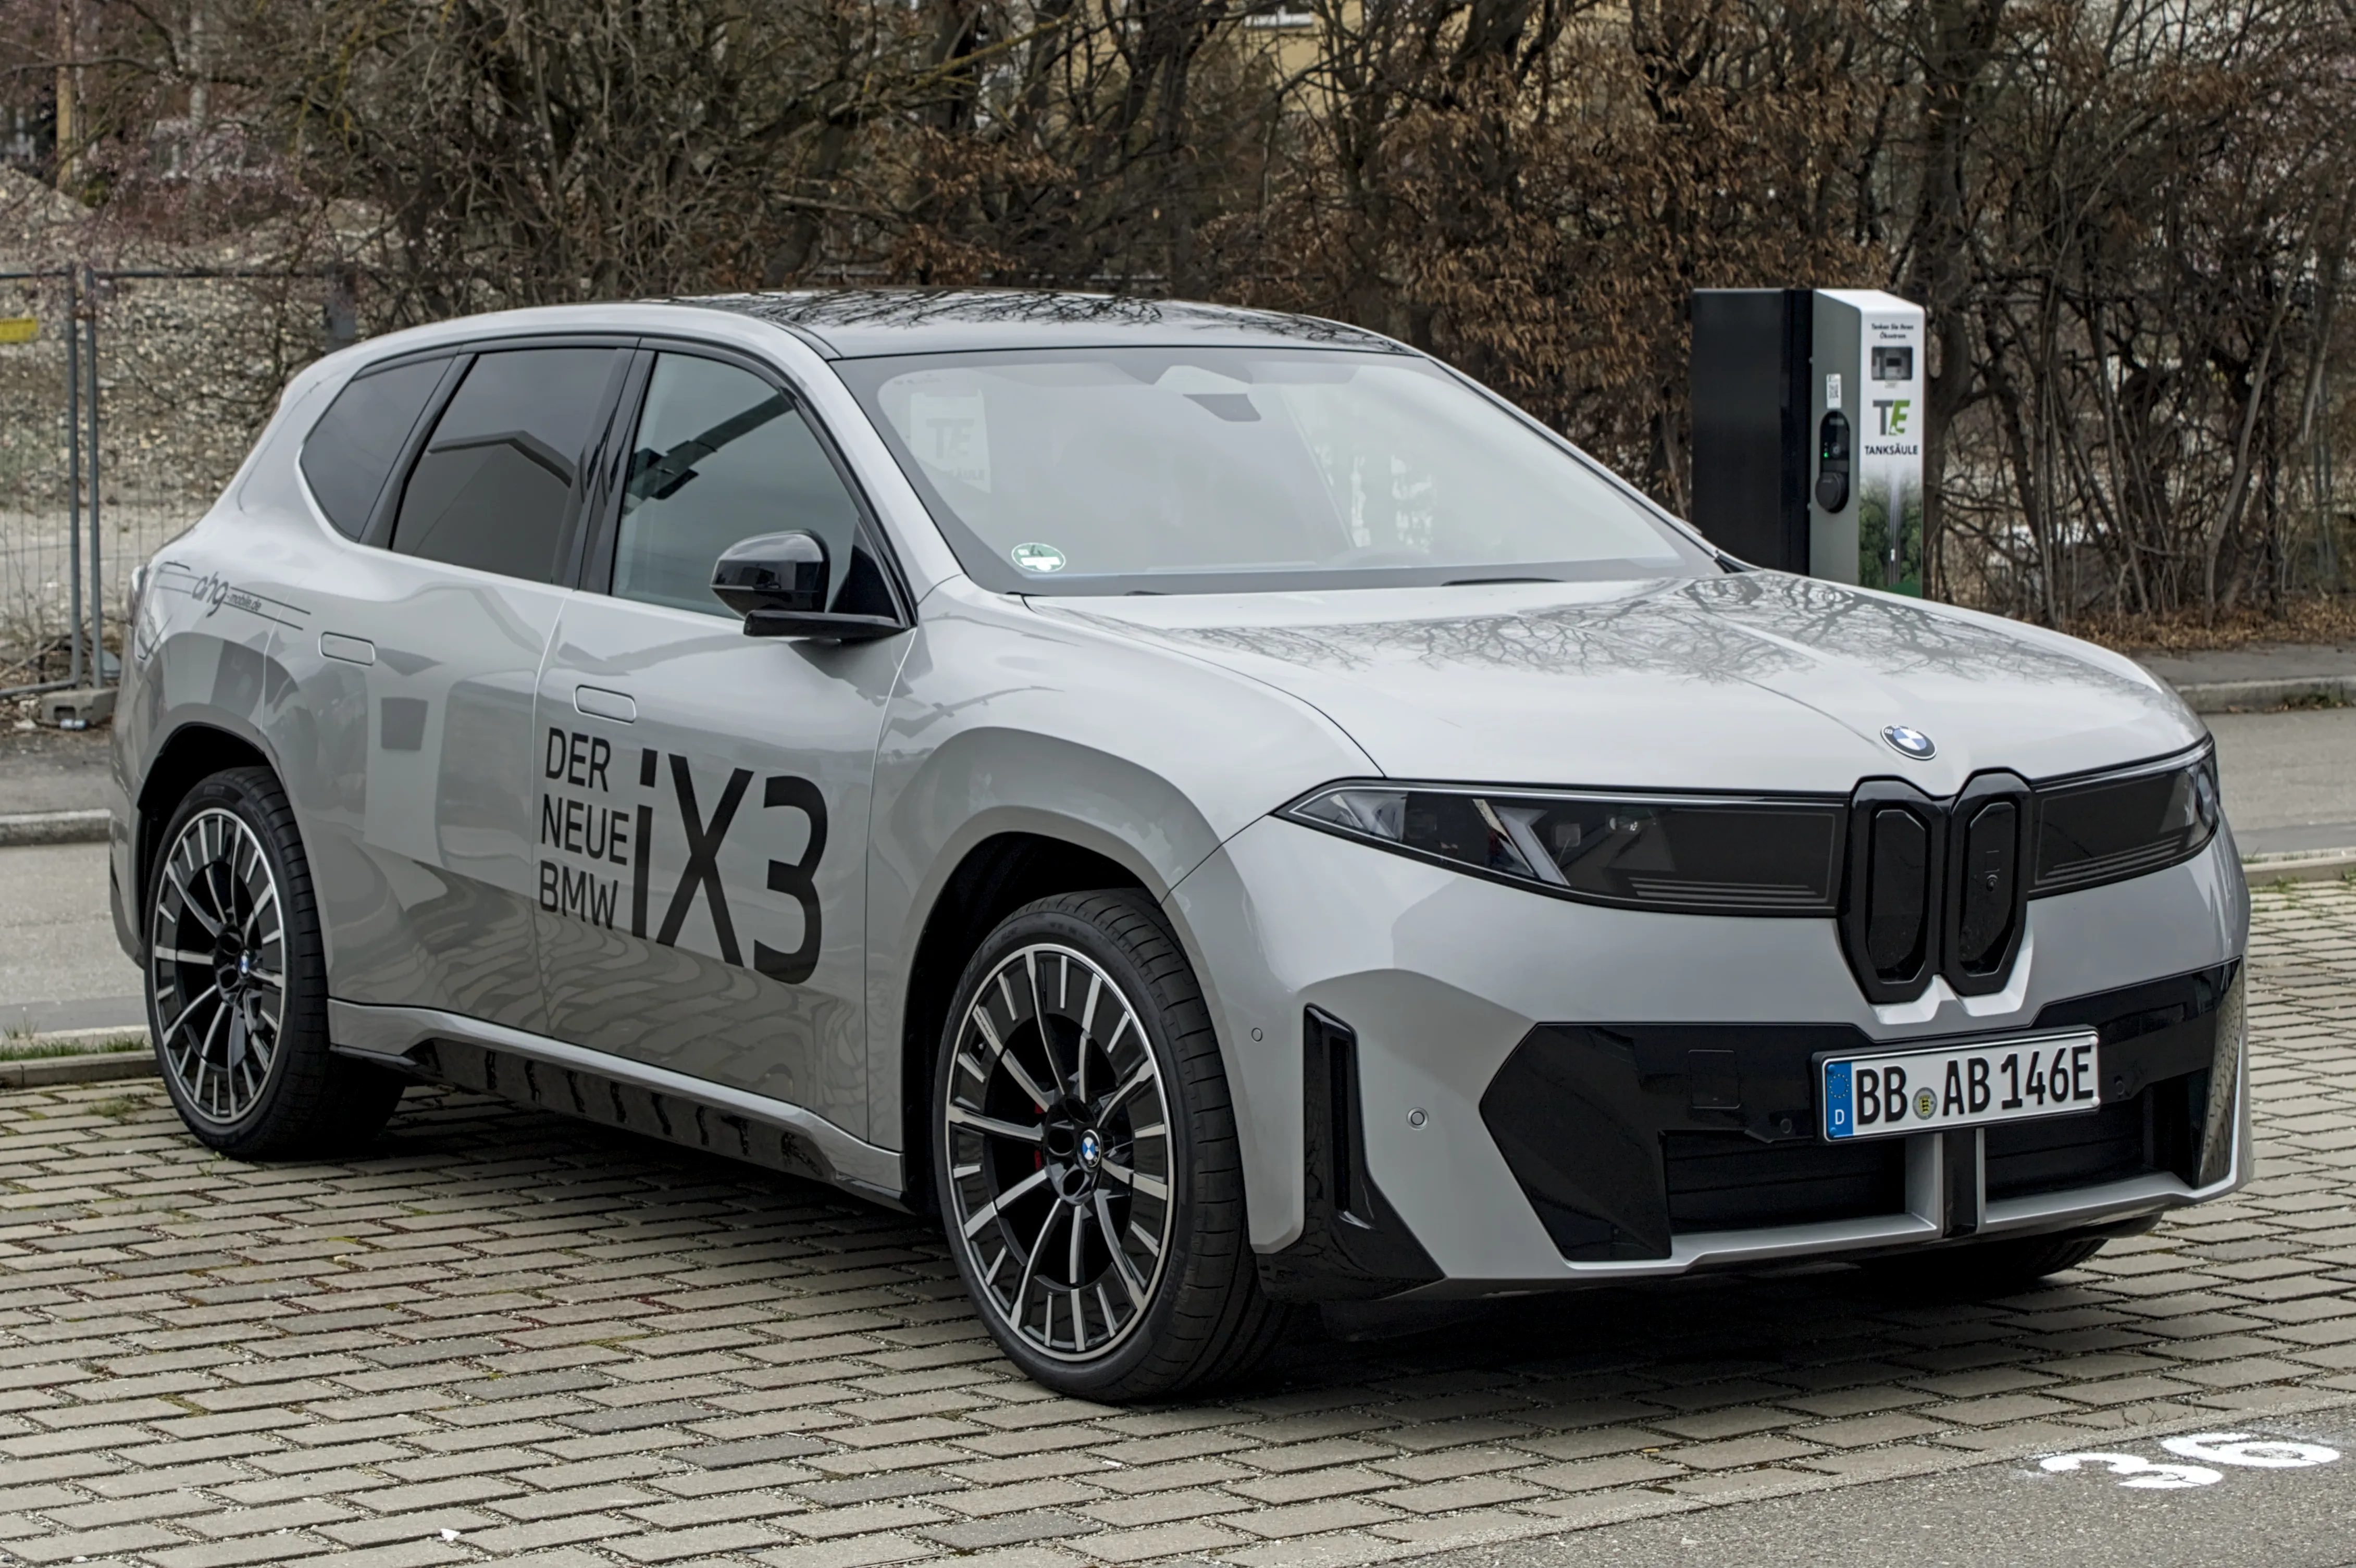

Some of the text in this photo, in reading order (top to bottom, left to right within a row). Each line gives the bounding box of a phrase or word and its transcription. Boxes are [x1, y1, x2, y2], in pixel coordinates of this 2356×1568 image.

[1865, 443, 1918, 455] TANKSÄULE
[1873, 400, 1910, 435] TE
[545, 727, 611, 792] DER
[541, 794, 629, 866] NEUE
[540, 860, 618, 930] BMW
[632, 748, 828, 985] iX3
[1834, 1109, 1845, 1125] D
[1856, 1044, 2094, 1125] BB AB 146E
[2036, 1432, 2340, 1489] 36
